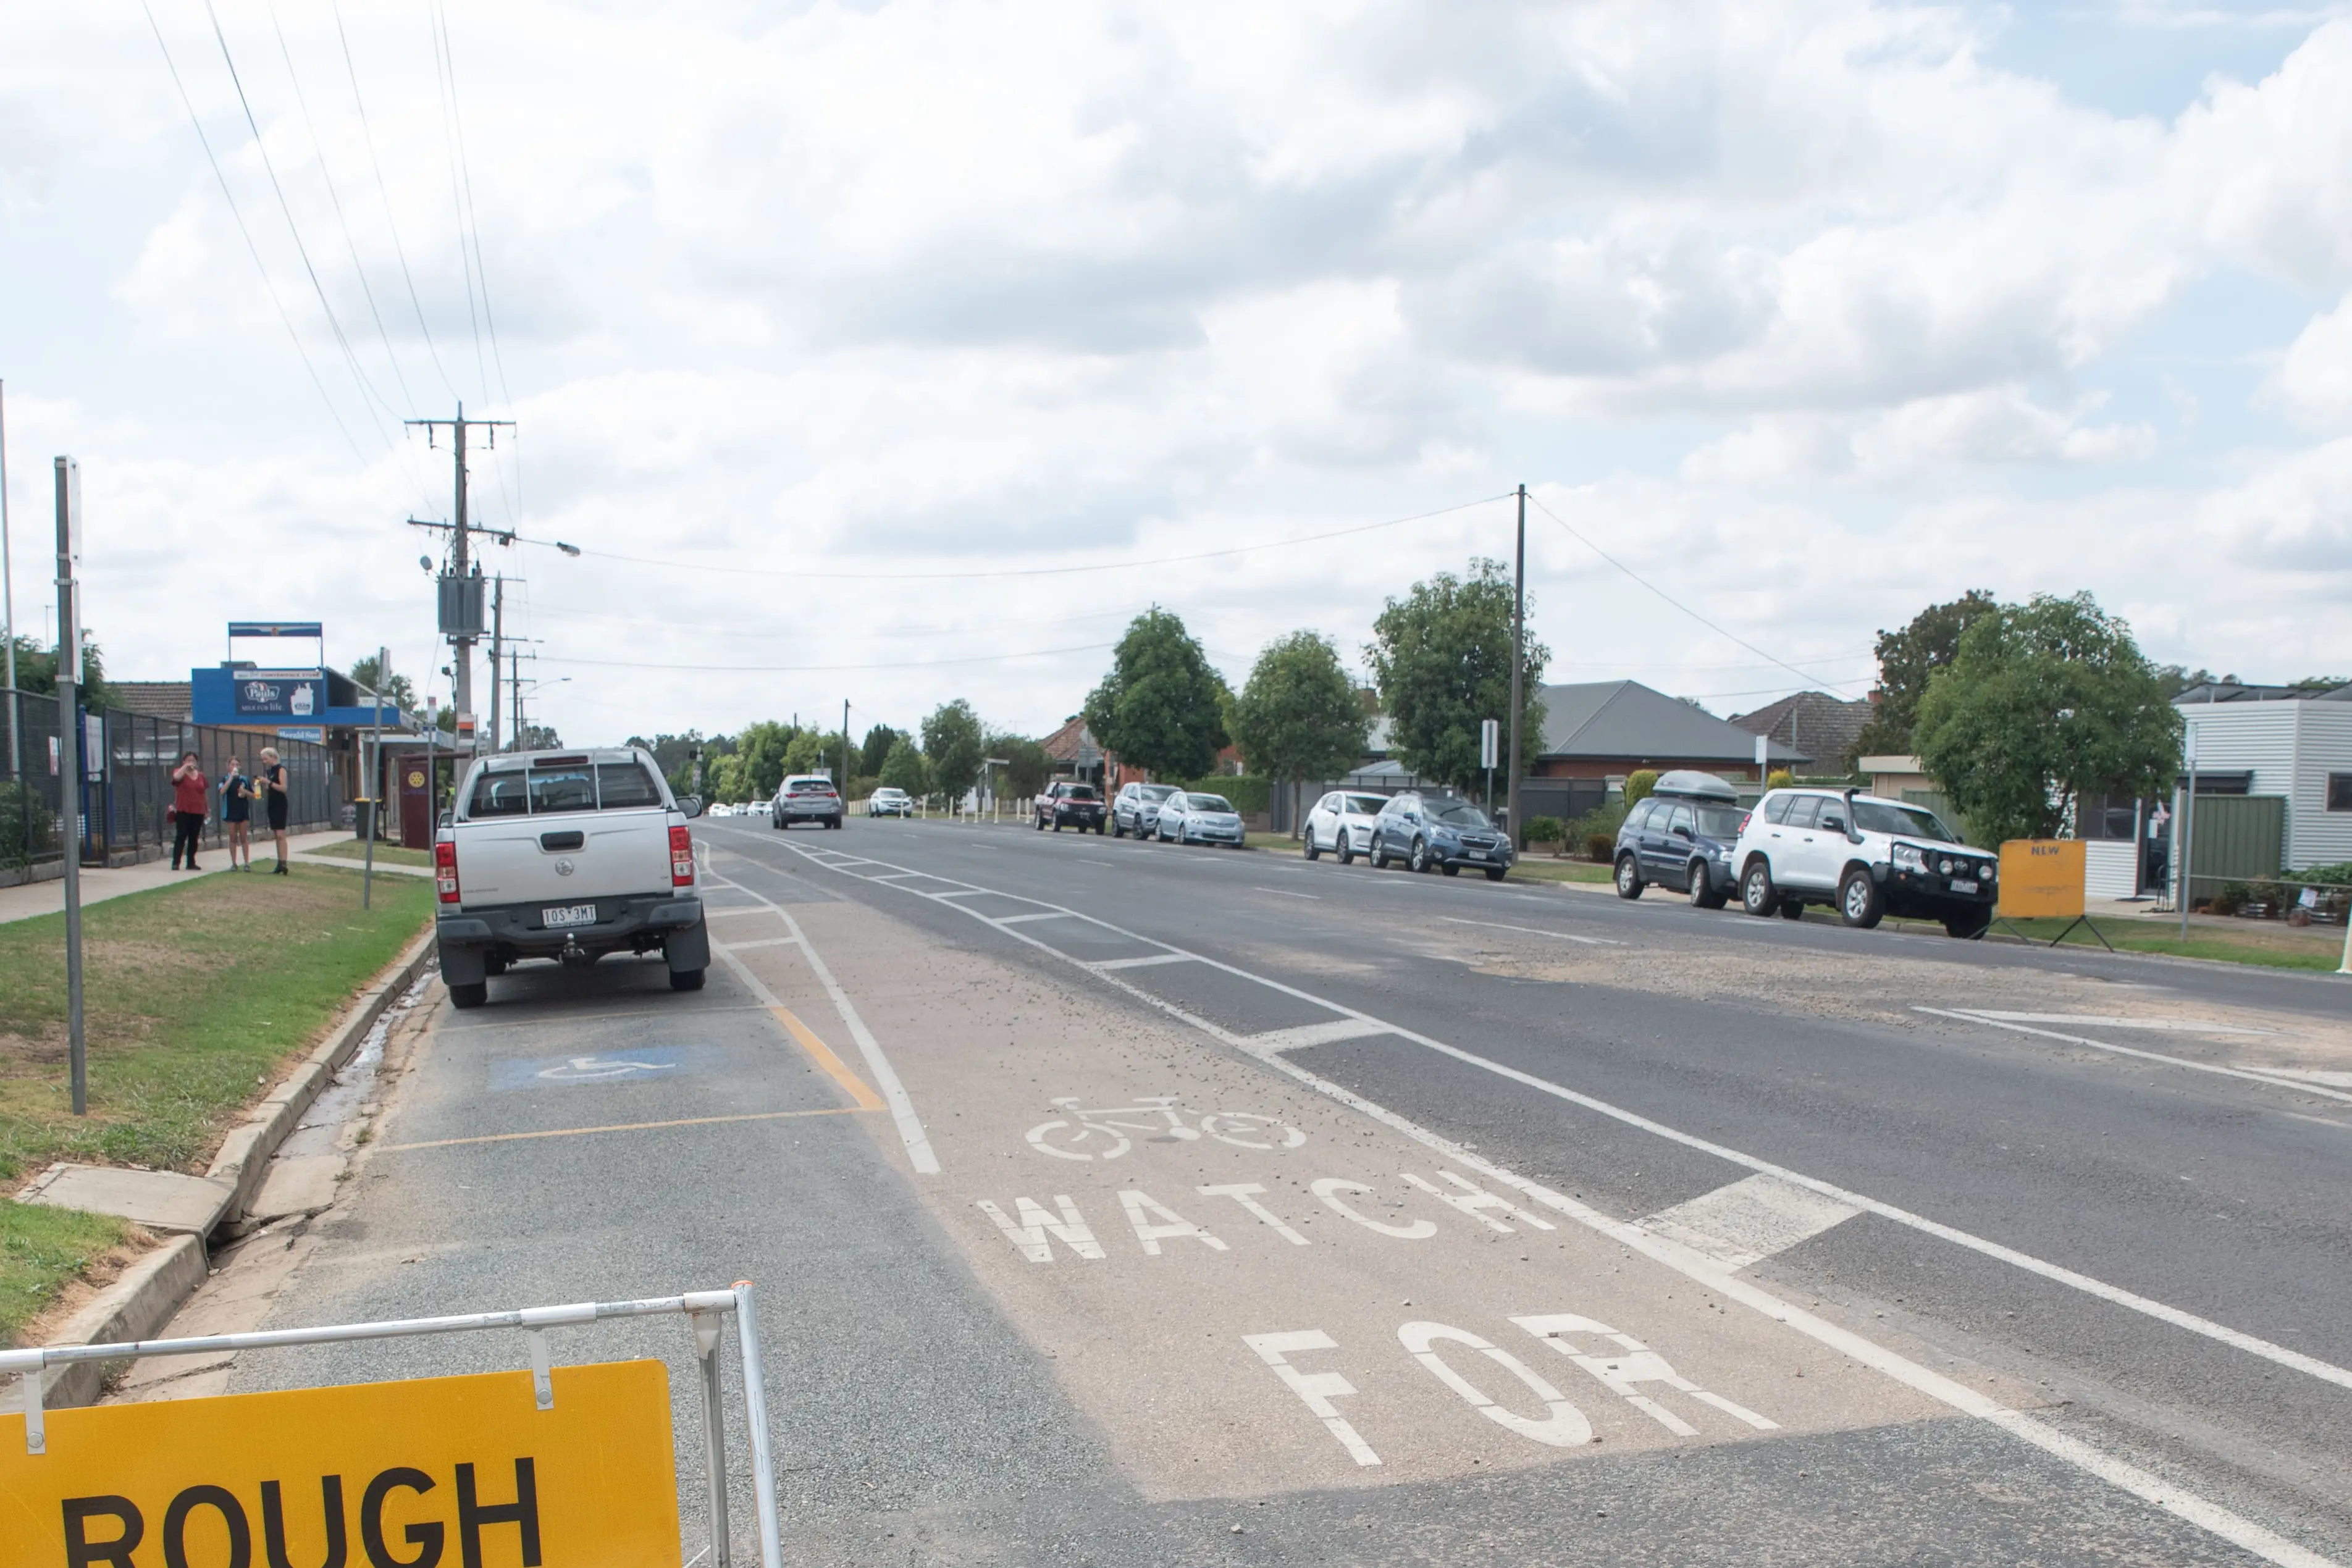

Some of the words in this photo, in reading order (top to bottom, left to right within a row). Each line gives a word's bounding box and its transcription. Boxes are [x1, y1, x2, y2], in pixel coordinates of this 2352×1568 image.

[250, 688, 276, 698] Pauls
[279, 730, 304, 739] Herald
[305, 731, 321, 739] Sun
[2031, 845, 2060, 855] NEW
[976, 1168, 1557, 1263] WATCH
[1241, 1313, 1783, 1467] FOR
[61, 1456, 542, 1568] ROUGH
